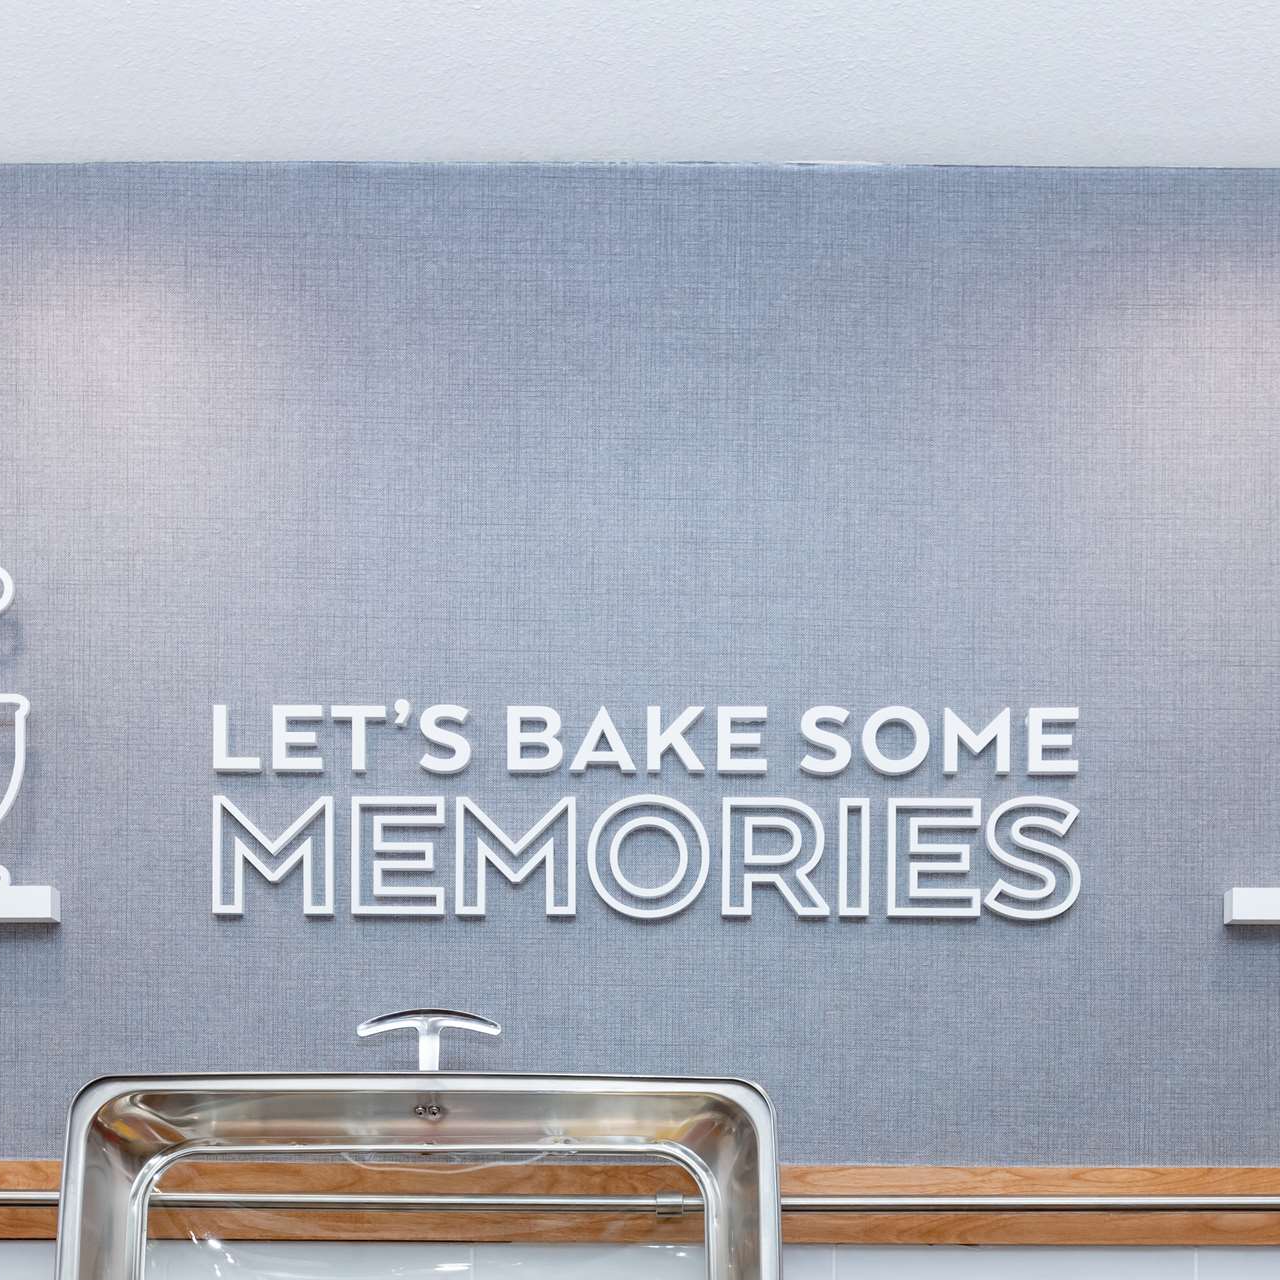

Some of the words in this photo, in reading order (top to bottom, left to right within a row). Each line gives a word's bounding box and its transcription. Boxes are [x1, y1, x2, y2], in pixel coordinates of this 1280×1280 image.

[212, 698, 471, 771] LET'S
[506, 705, 768, 771] BAKE
[800, 705, 1080, 773] SOME
[212, 793, 1081, 919] MEMORIES
